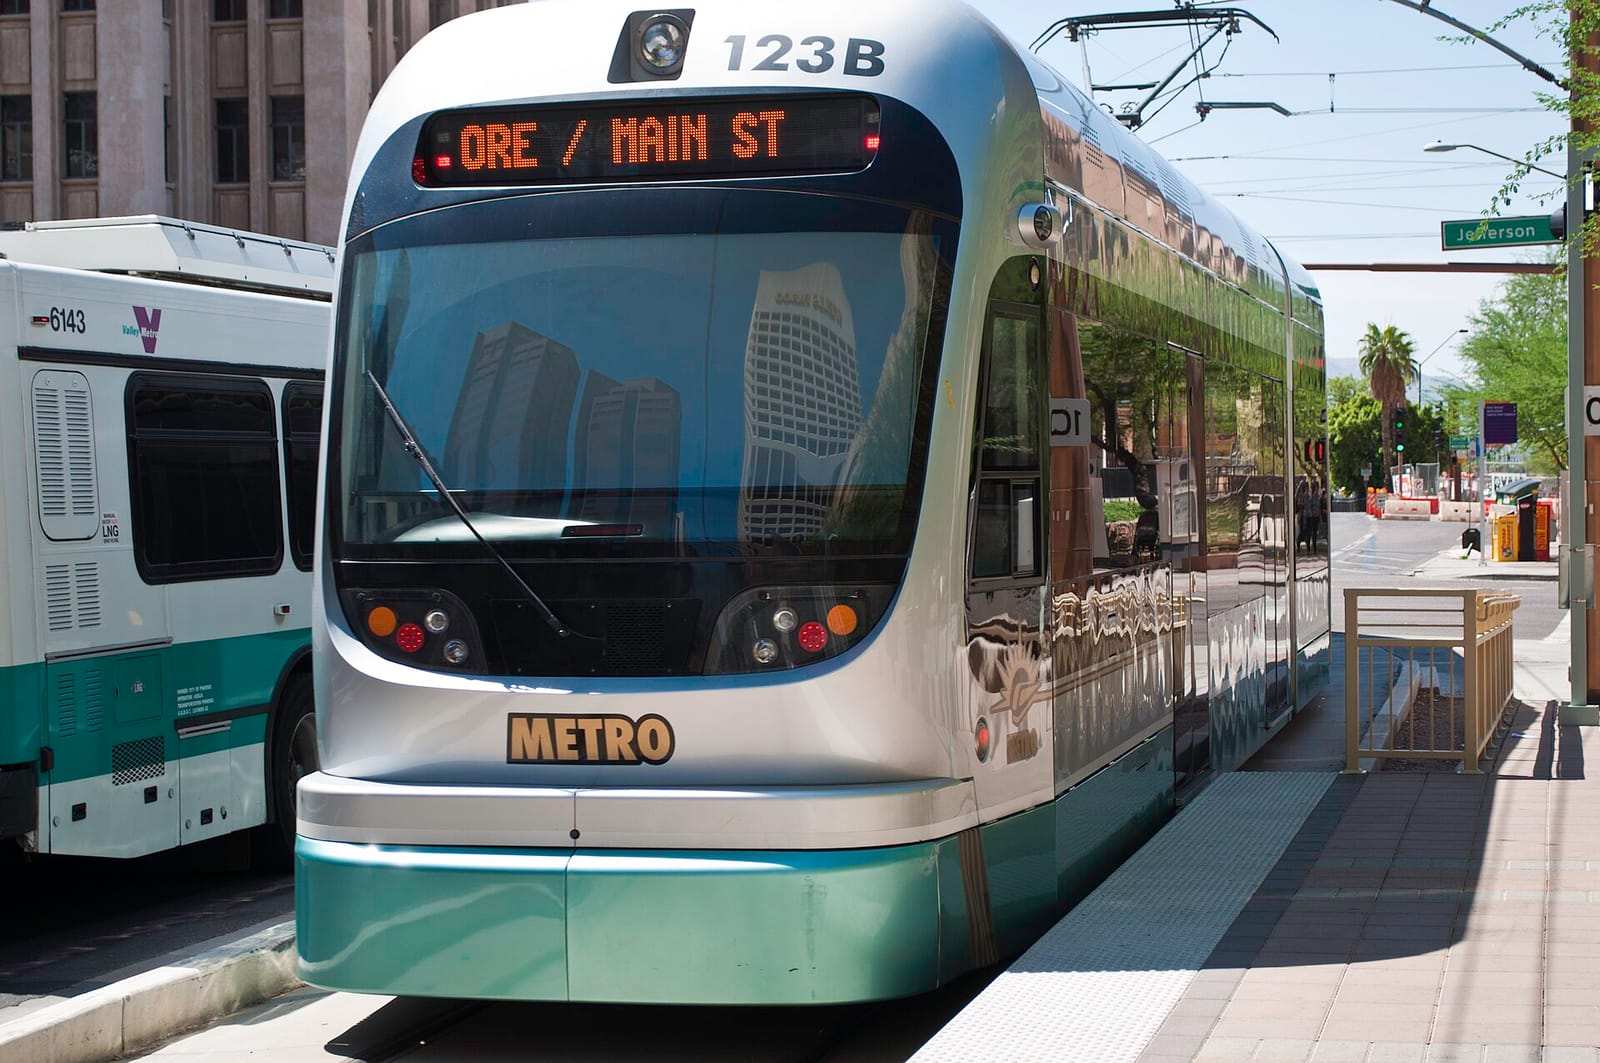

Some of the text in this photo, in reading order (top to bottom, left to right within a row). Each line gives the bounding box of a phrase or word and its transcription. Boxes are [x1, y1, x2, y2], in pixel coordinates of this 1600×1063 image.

[723, 35, 886, 78] 123B
[460, 121, 538, 170] ORE
[612, 114, 707, 164] MAIN
[732, 110, 785, 159] ST
[1457, 226, 1535, 241] Jeerson
[50, 307, 86, 334] 6143
[122, 325, 139, 337] Valley
[102, 524, 119, 538] LNG
[510, 716, 672, 762] METRO
